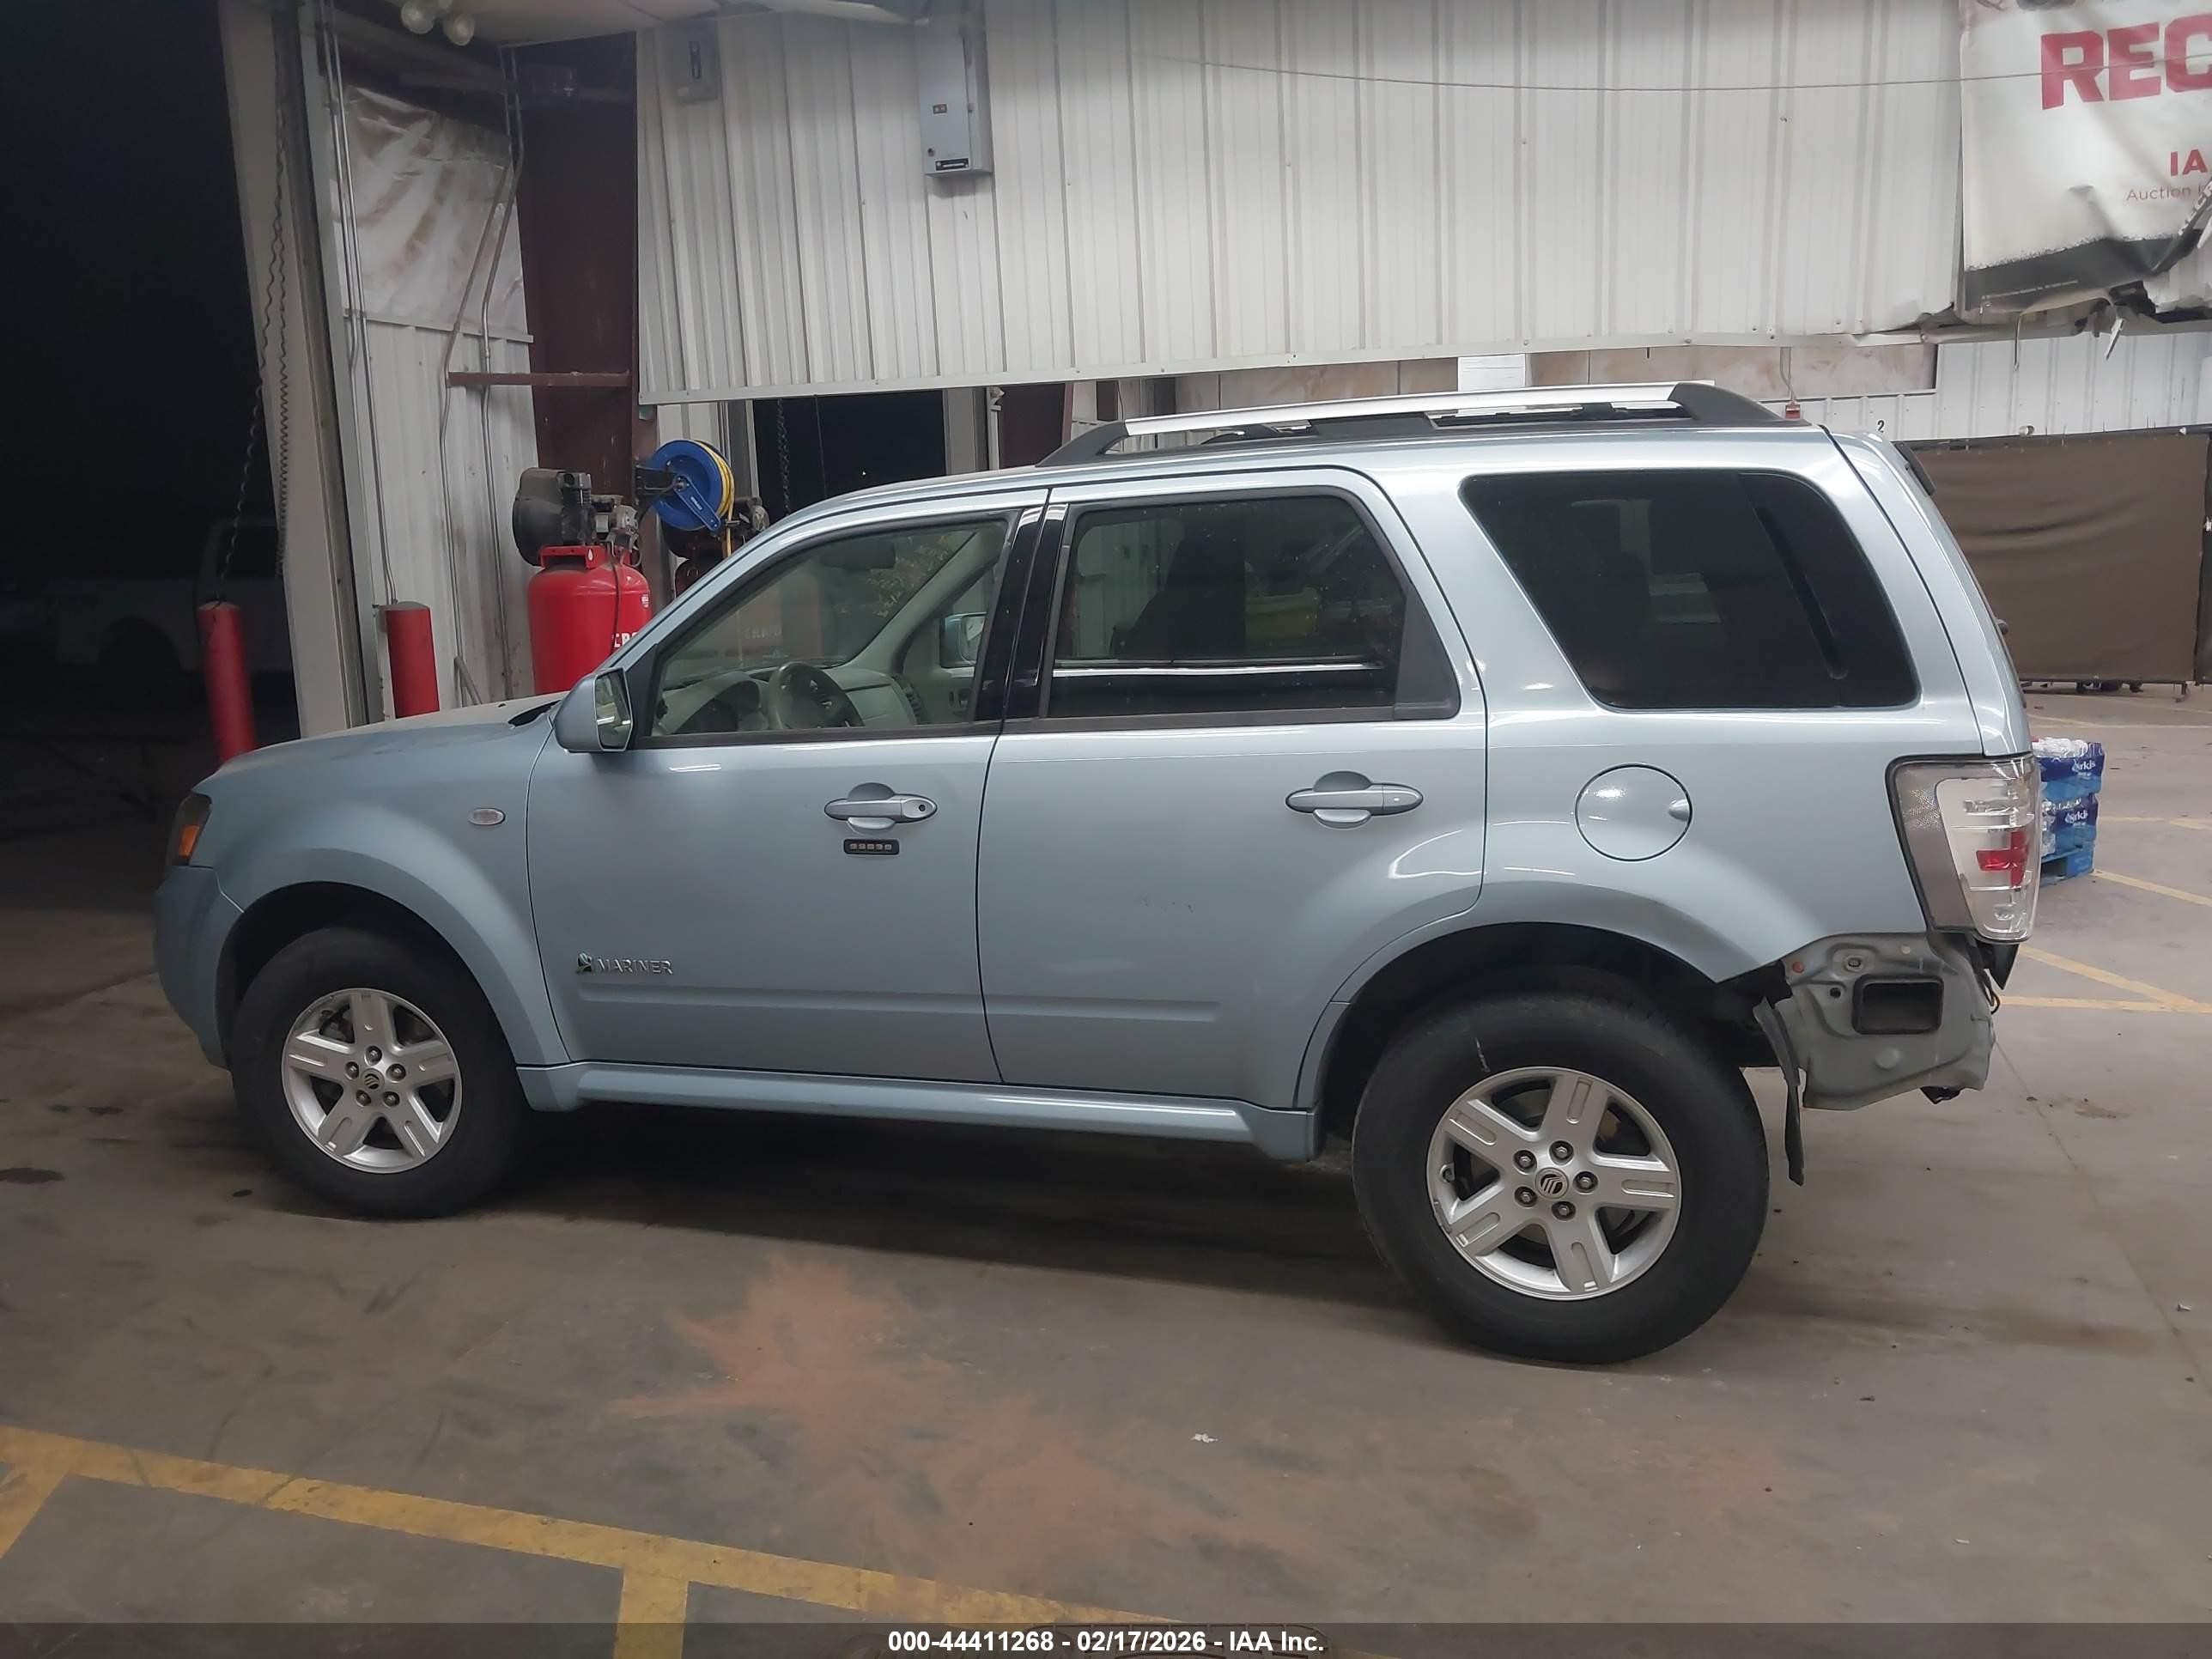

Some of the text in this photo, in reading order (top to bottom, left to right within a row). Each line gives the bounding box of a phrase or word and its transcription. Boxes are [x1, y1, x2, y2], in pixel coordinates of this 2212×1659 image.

[2125, 185, 2192, 201] Auction
[1877, 420, 1885, 433] 2
[597, 957, 673, 975] MARINER
